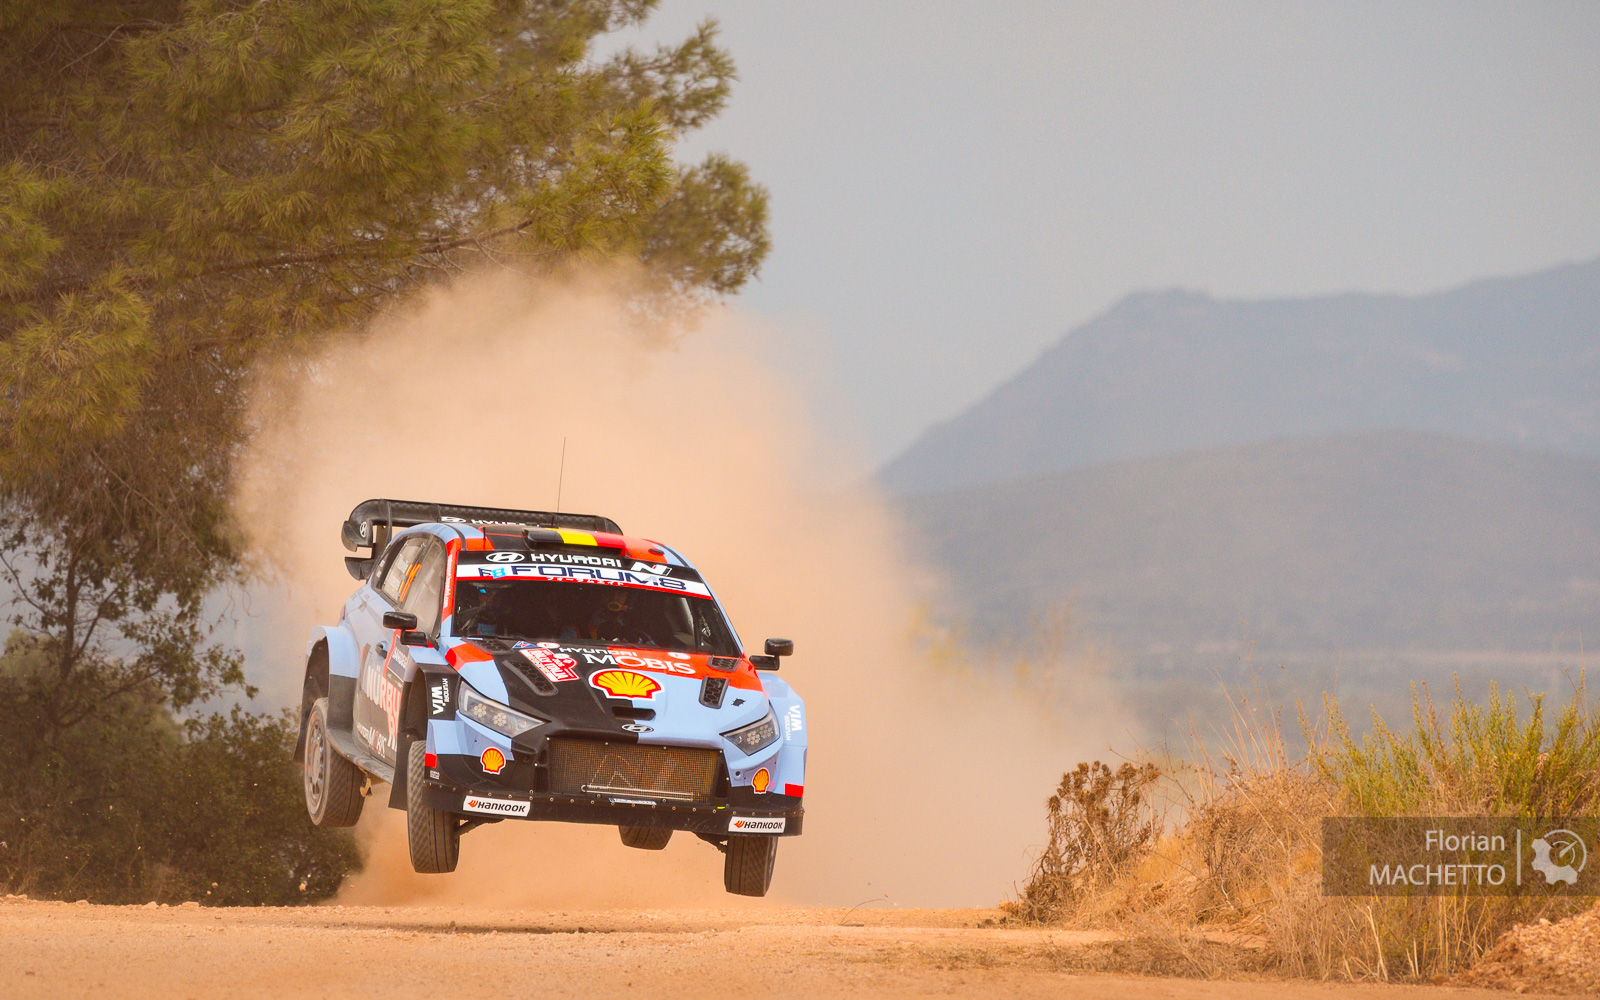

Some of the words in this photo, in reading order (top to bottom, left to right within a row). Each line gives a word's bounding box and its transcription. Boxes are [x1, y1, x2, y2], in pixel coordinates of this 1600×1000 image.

[530, 553, 622, 568] HYUNDAI
[511, 565, 686, 591] FORUM8
[559, 647, 637, 657] HYUNDAI
[582, 653, 696, 675] MOBIS
